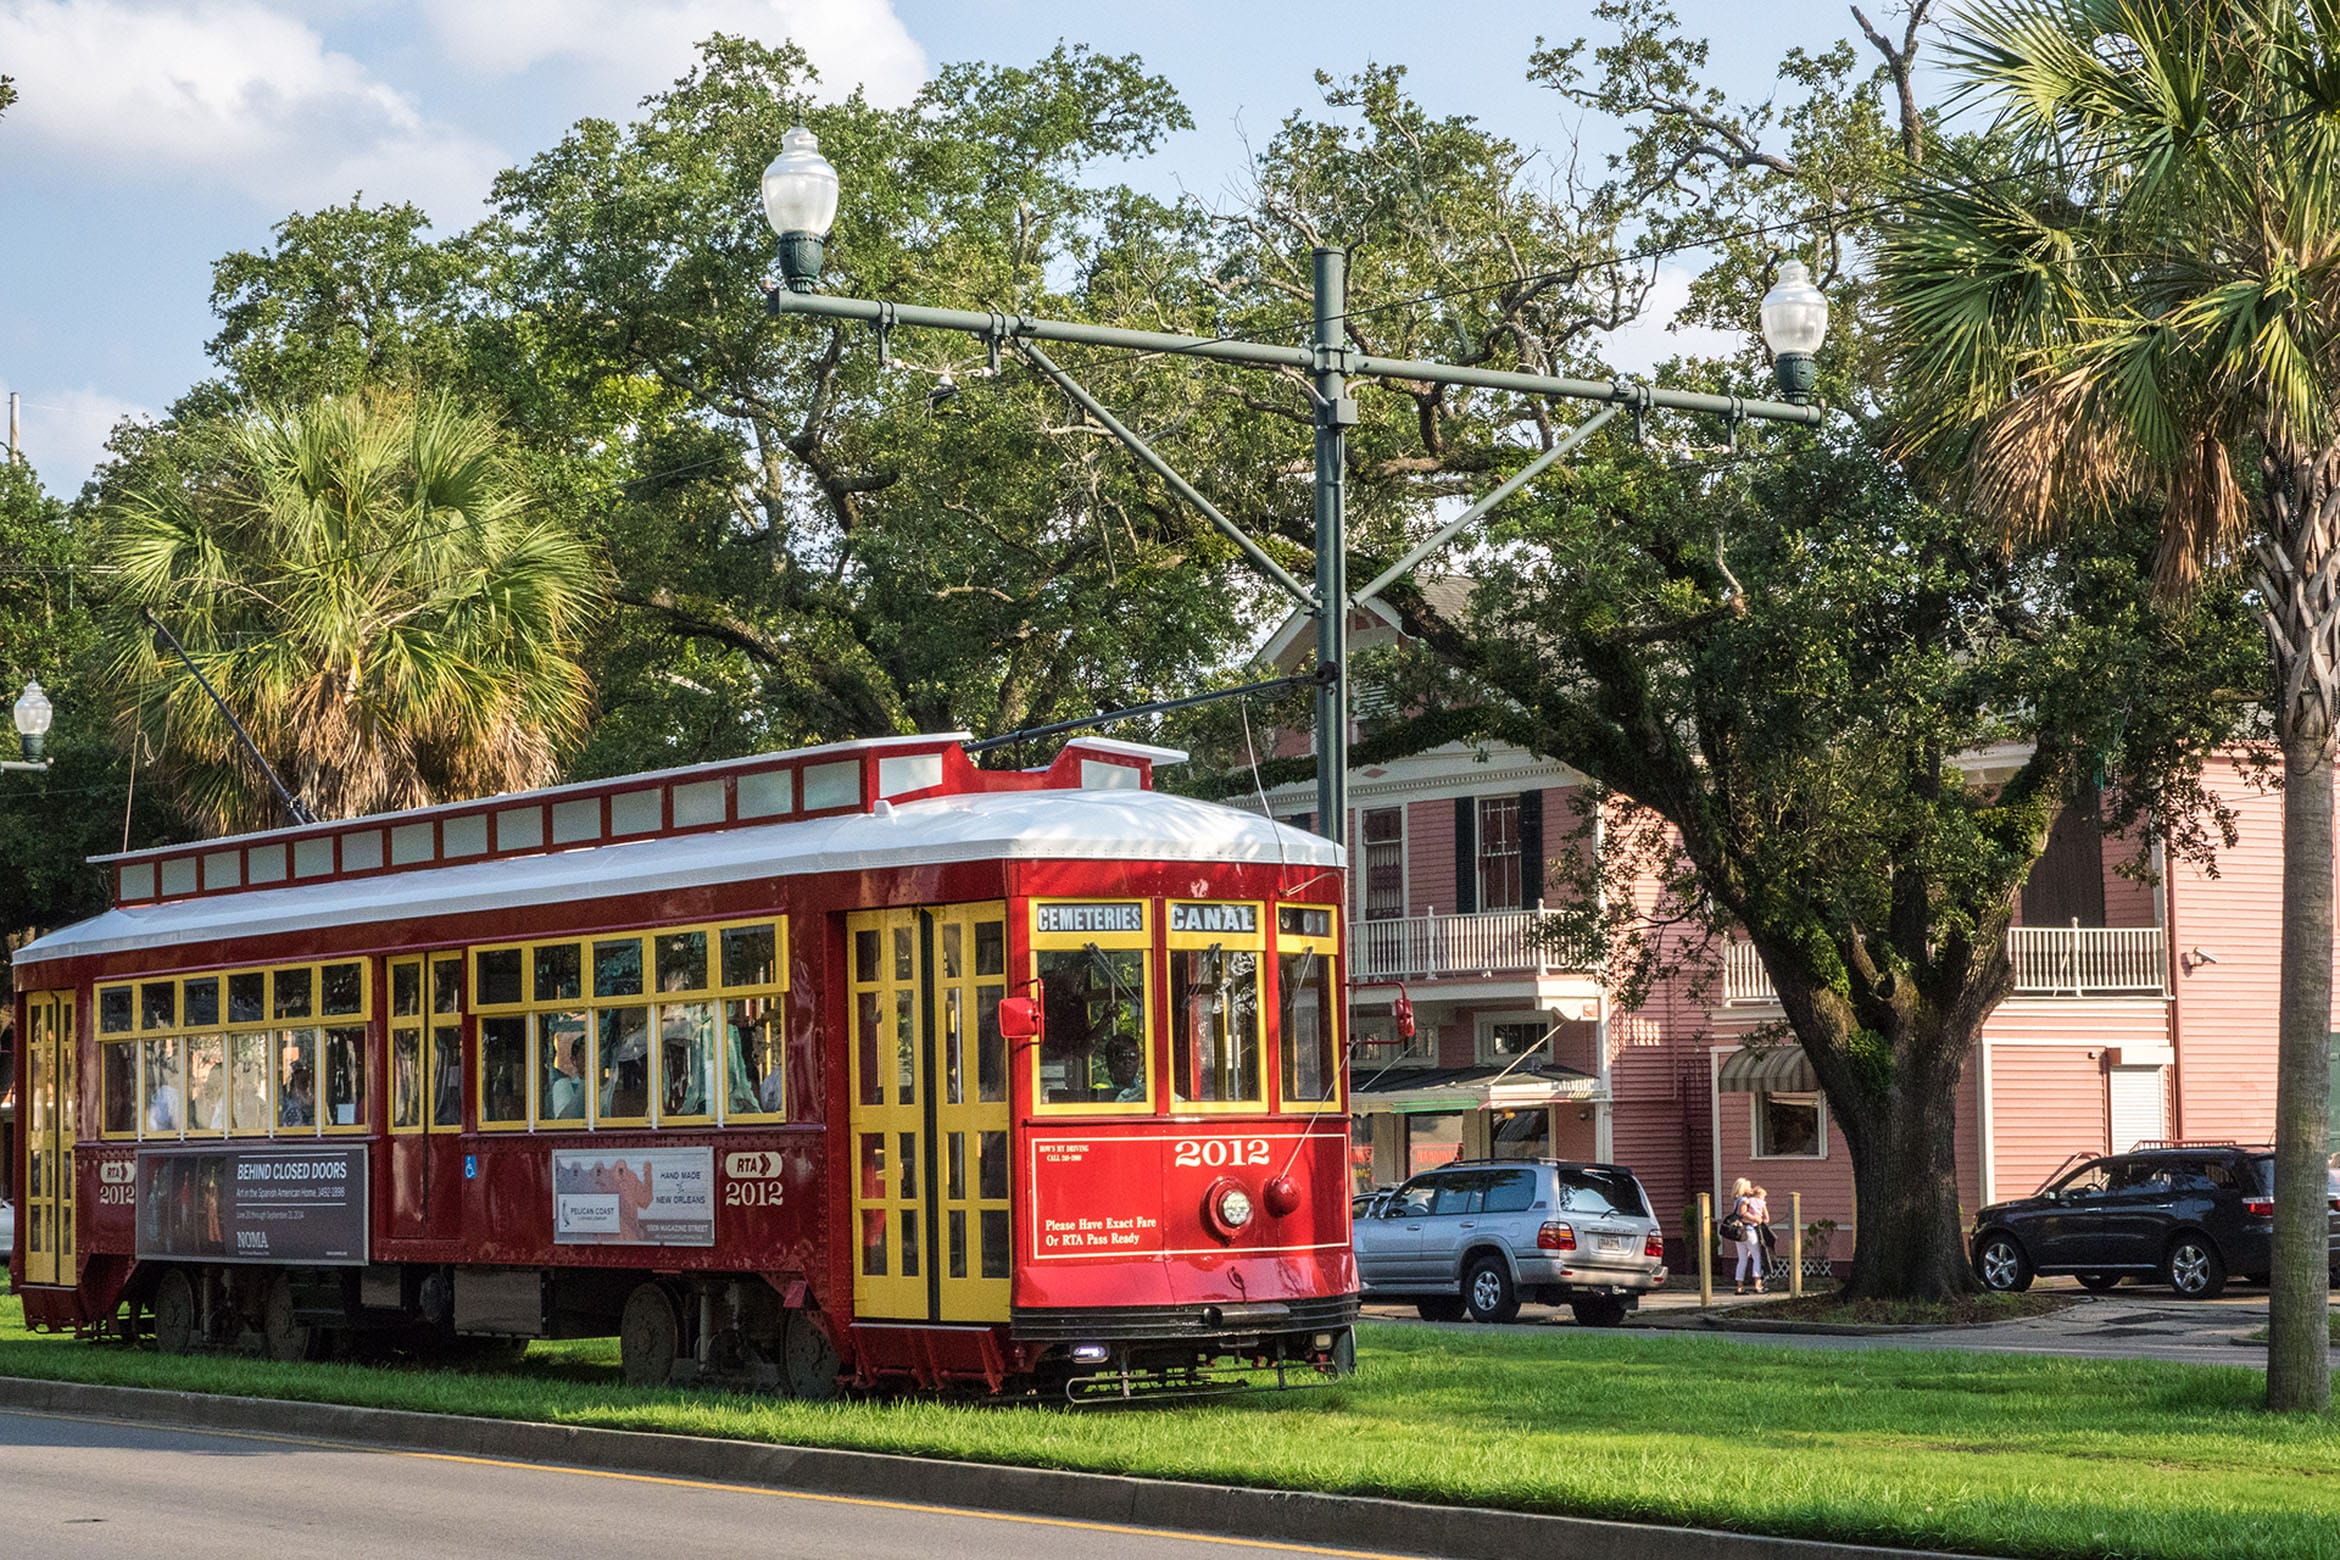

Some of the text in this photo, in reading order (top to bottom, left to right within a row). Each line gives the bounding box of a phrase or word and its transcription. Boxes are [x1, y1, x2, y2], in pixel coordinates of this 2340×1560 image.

[1037, 906, 1142, 931] CEMETERIES
[1170, 905, 1255, 932] CANAL
[1066, 1144, 1089, 1152] DRIVING
[1174, 1139, 1270, 1168] 2012
[107, 1167, 120, 1178] RTA
[237, 1161, 348, 1180] BEHIND CLOSED DOORS
[737, 1158, 757, 1173] RTA
[660, 1171, 702, 1180] HAND MADE
[99, 1185, 135, 1205] 2012
[236, 1188, 244, 1197] Art
[249, 1188, 258, 1197] the
[258, 1187, 277, 1199] Spanish
[278, 1188, 300, 1197] American
[656, 1196, 706, 1204] NEW ORLEANS
[725, 1181, 784, 1206] 2012
[570, 1207, 614, 1215] PELICAN COAST
[660, 1224, 687, 1232] MAGAZINE
[687, 1224, 708, 1232] STREET
[1045, 1216, 1157, 1231] Please Have Exact Fare
[236, 1231, 269, 1249] NOMA
[1046, 1232, 1140, 1246] Or RTA Pass Ready
